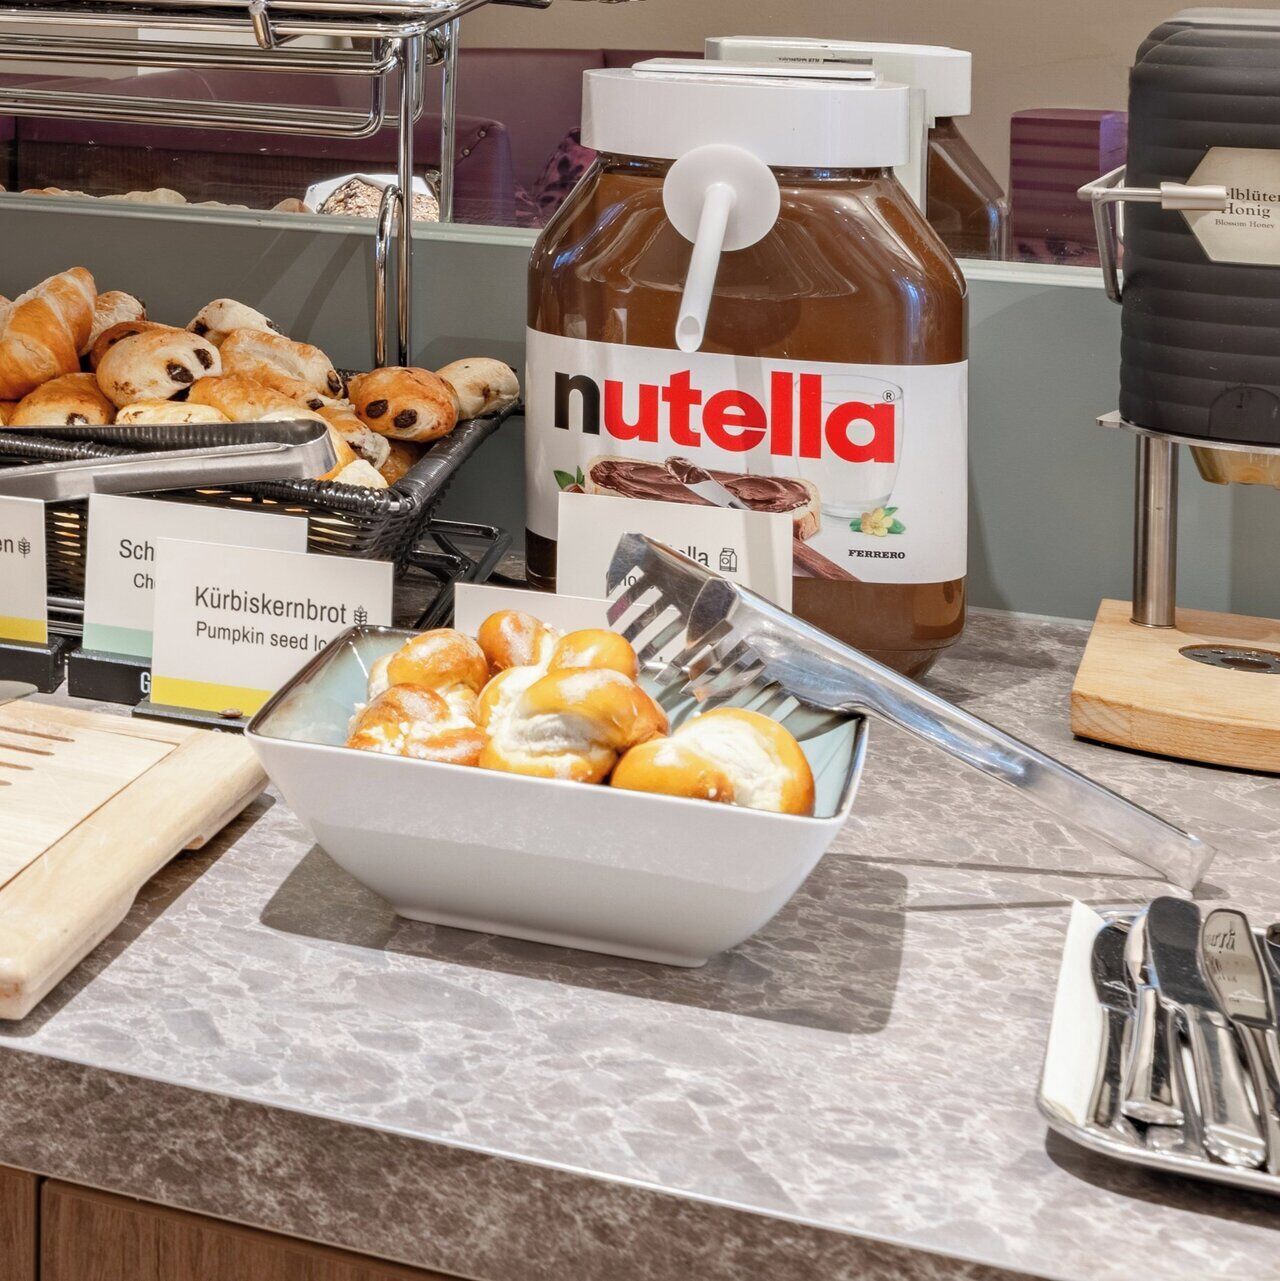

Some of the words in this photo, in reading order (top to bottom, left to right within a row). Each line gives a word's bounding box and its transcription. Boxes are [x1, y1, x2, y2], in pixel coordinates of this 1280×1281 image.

[1221, 203, 1271, 219] Honig
[1215, 219, 1246, 227] Blossom
[1249, 221, 1275, 229] Honey
[553, 370, 895, 464] nutella
[119, 538, 155, 562] Sch
[848, 549, 906, 560] FERRERO
[133, 573, 156, 590] Ch
[195, 586, 347, 624] Kürbiskernbrot
[196, 621, 264, 645] Pumpkin
[270, 634, 308, 652] seed
